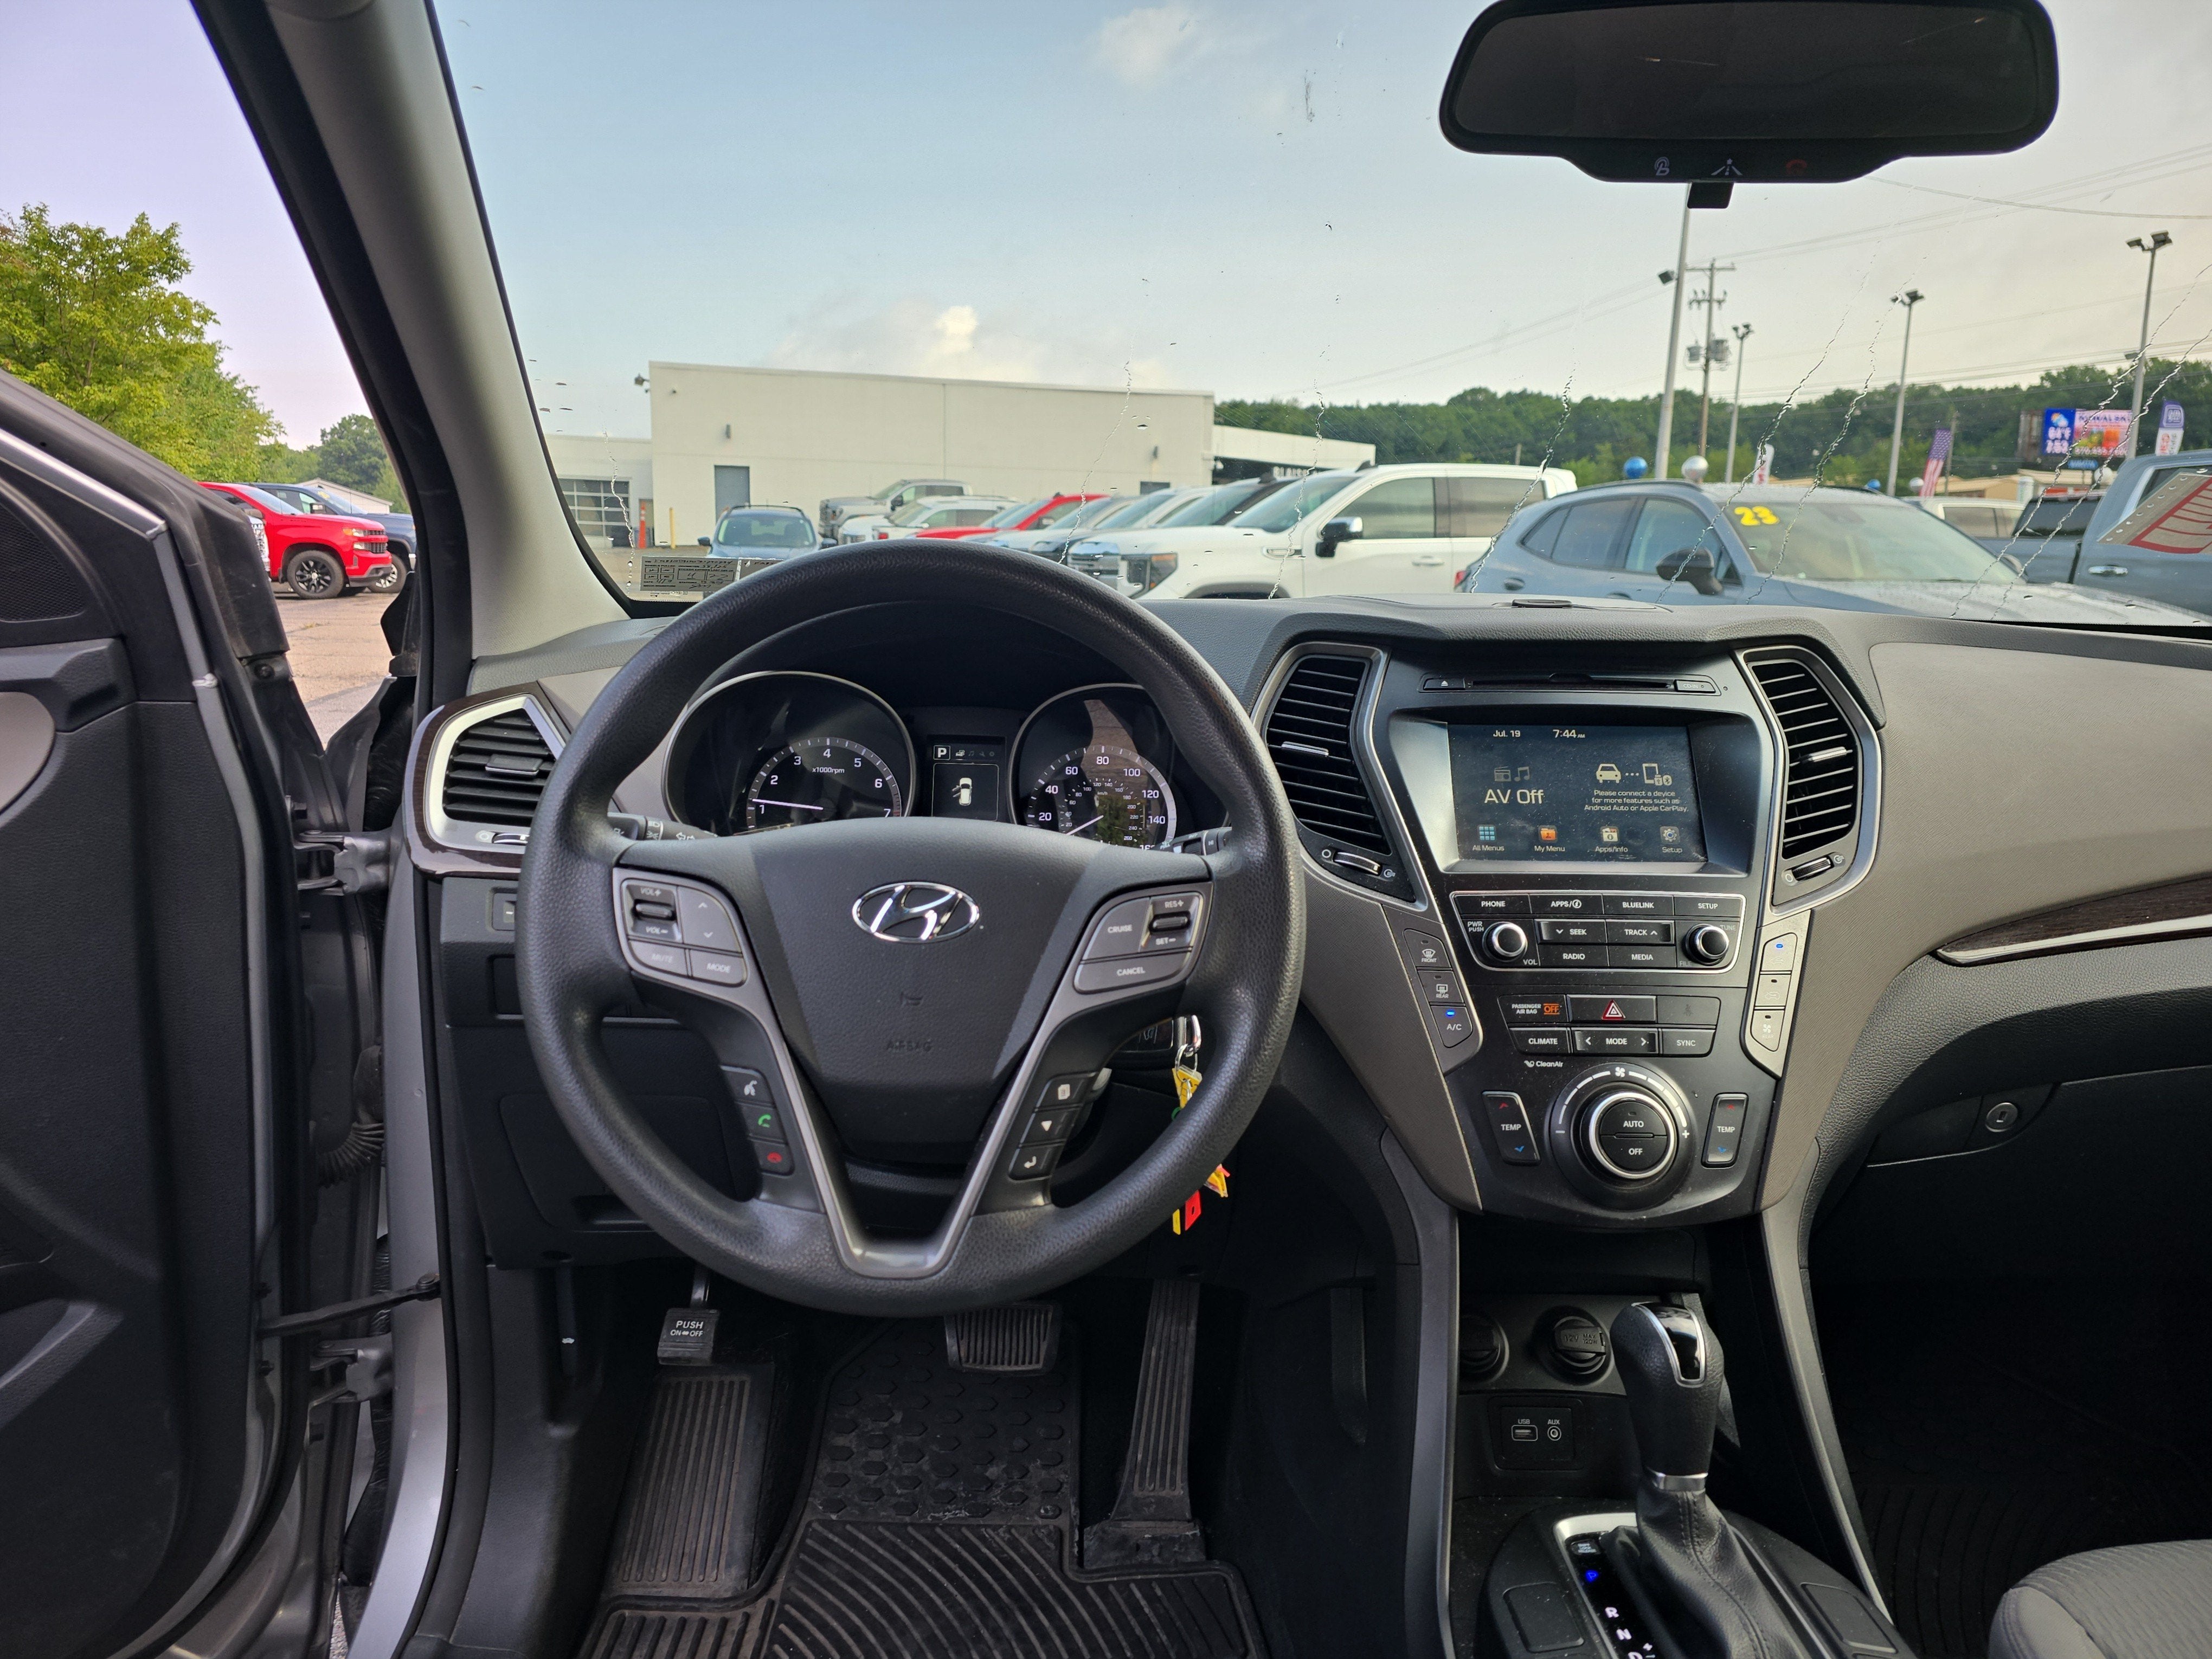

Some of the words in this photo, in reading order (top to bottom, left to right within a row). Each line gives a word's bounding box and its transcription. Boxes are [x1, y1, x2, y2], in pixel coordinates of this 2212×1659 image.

[1734, 505, 1780, 526] 23
[1553, 729, 1577, 738] 7:44
[824, 748, 831, 758] 4
[937, 748, 947, 758] P
[794, 756, 801, 766] 3
[854, 758, 861, 767] 5
[1096, 756, 1109, 765] 80
[1065, 766, 1078, 776] 60
[1123, 768, 1141, 777] 100
[770, 775, 778, 785] 2
[874, 778, 883, 788] 6
[1045, 785, 1058, 795] 40
[1142, 789, 1159, 799] 120
[1484, 789, 1511, 804] AV
[1516, 789, 1544, 805] Off
[760, 805, 764, 814] 1
[1039, 812, 1052, 821] 20
[1148, 815, 1166, 824] 140
[1108, 924, 1133, 933] CRUISE
[706, 963, 731, 973] MODE
[1117, 967, 1146, 976] CANCEL
[676, 1320, 704, 1329] PUSH
[1564, 1334, 1579, 1342] 12V
[1605, 1606, 1619, 1618] R
[1616, 1628, 1632, 1641] N
